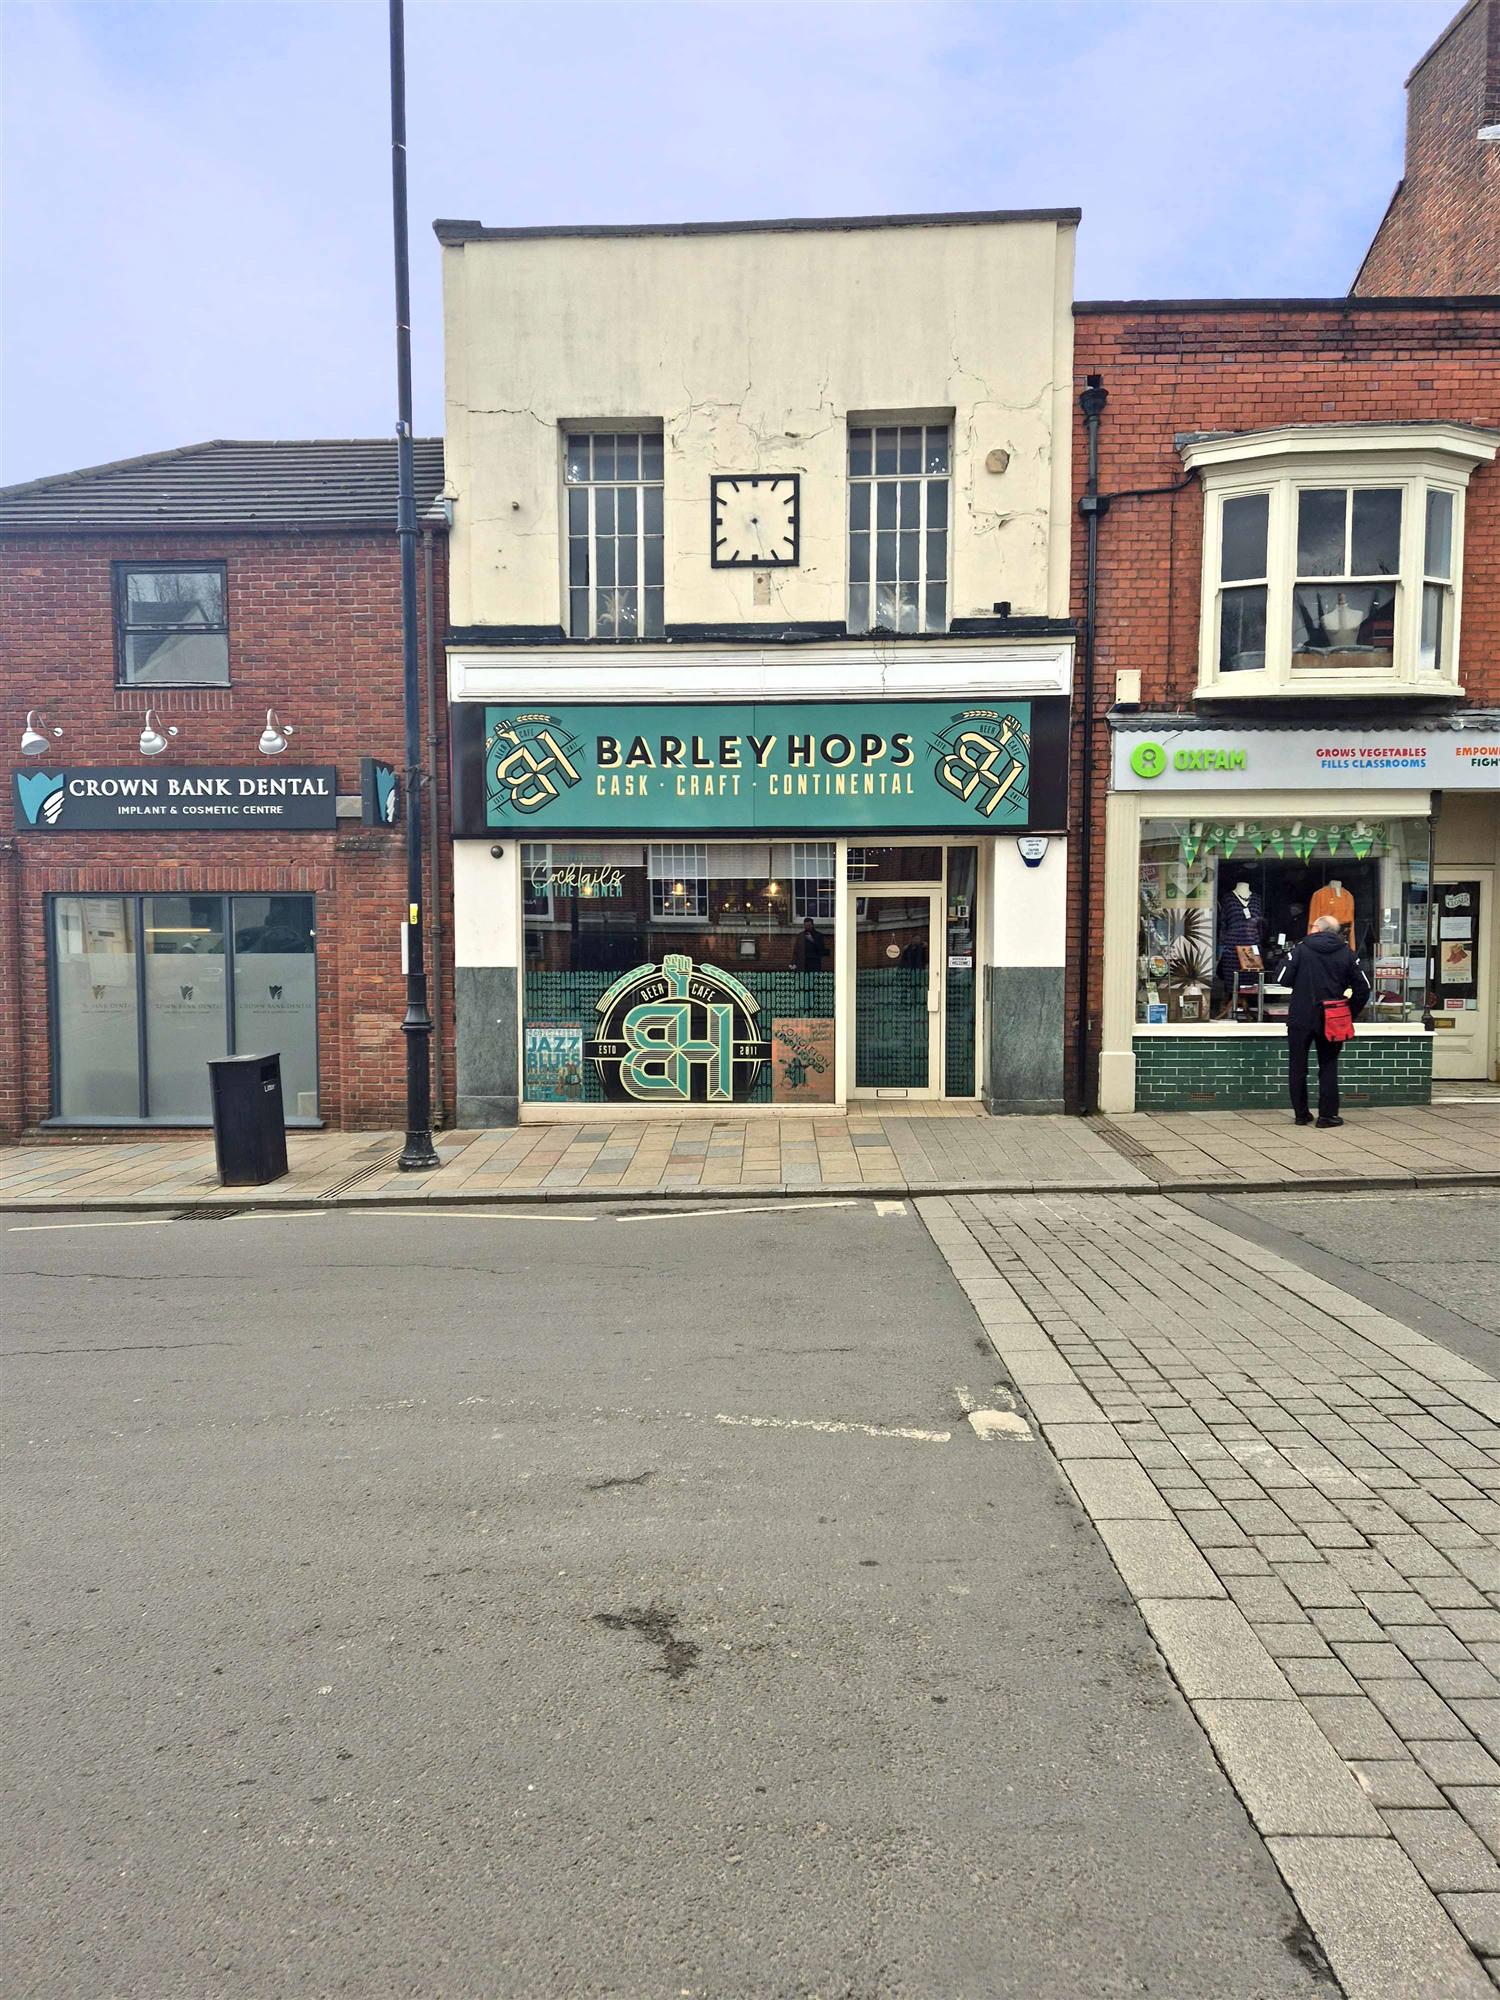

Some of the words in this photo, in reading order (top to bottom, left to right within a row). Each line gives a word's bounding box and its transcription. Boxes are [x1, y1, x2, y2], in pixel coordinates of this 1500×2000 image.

[597, 735, 778, 769] BARLEY
[788, 733, 915, 768] HOPS
[1316, 747, 1356, 757] GROWS
[1359, 747, 1427, 757] VEGETABLES
[1456, 746, 1500, 756] EMPOW
[1174, 748, 1246, 771] OXFAM
[1321, 759, 1350, 769] FILLS
[1352, 758, 1426, 768] CLASSROOMS
[1471, 758, 1500, 767] FIGH
[69, 778, 159, 797] CROWN
[168, 778, 232, 797] BANK
[239, 778, 329, 797] DENTAL
[596, 774, 649, 796] CASK
[676, 774, 741, 796] CRAFT
[769, 772, 914, 796] CONTINENTAL
[118, 805, 167, 815] IMPLANT
[170, 805, 177, 814] &
[182, 805, 239, 815] COSMETIC
[242, 805, 284, 814] CENTRE
[531, 859, 626, 889] Cocktails
[553, 882, 574, 897] THE
[578, 882, 623, 897] CRNER
[640, 983, 665, 1001] BEER
[691, 983, 716, 1002] CAFE
[527, 1036, 580, 1052] JAZZ
[739, 1046, 758, 1056] 2011
[527, 1053, 581, 1069] BLUES
